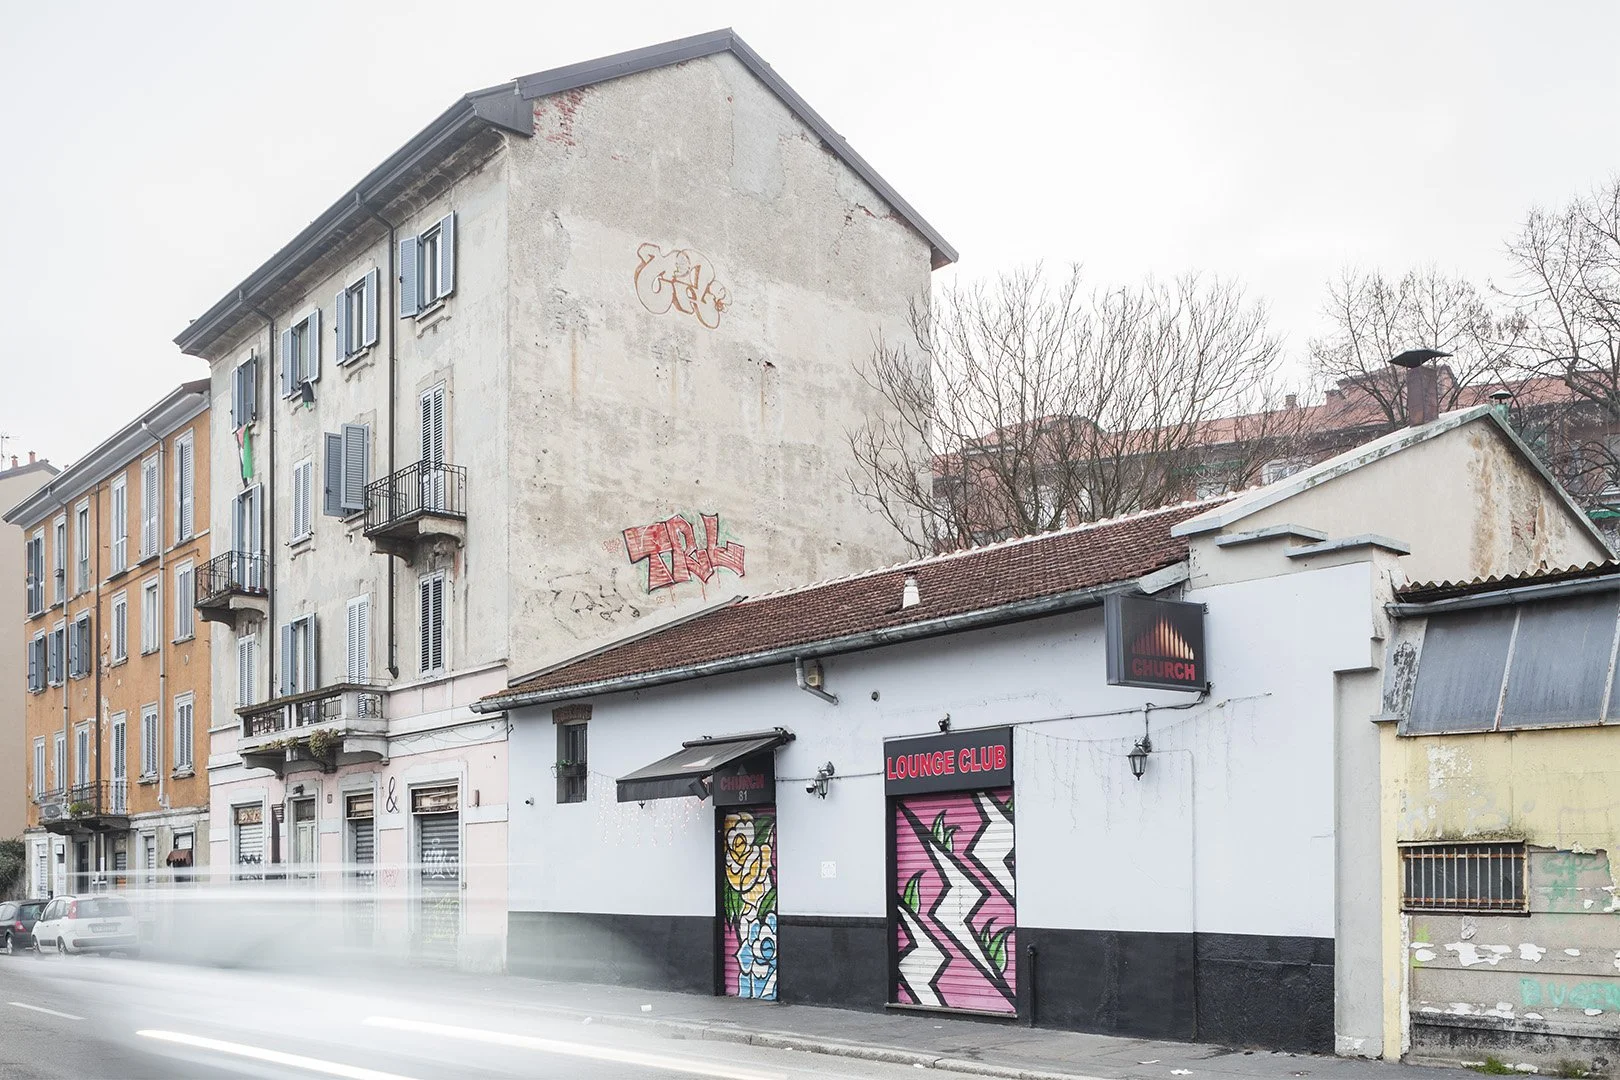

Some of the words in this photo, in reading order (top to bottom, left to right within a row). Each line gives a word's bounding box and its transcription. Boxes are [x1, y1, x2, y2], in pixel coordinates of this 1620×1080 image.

[1132, 658, 1195, 680] CHURCH
[887, 750, 954, 780] LOUNGE
[958, 745, 1006, 773] CLUB
[720, 774, 764, 791] CHURCH
[738, 790, 748, 801] 81
